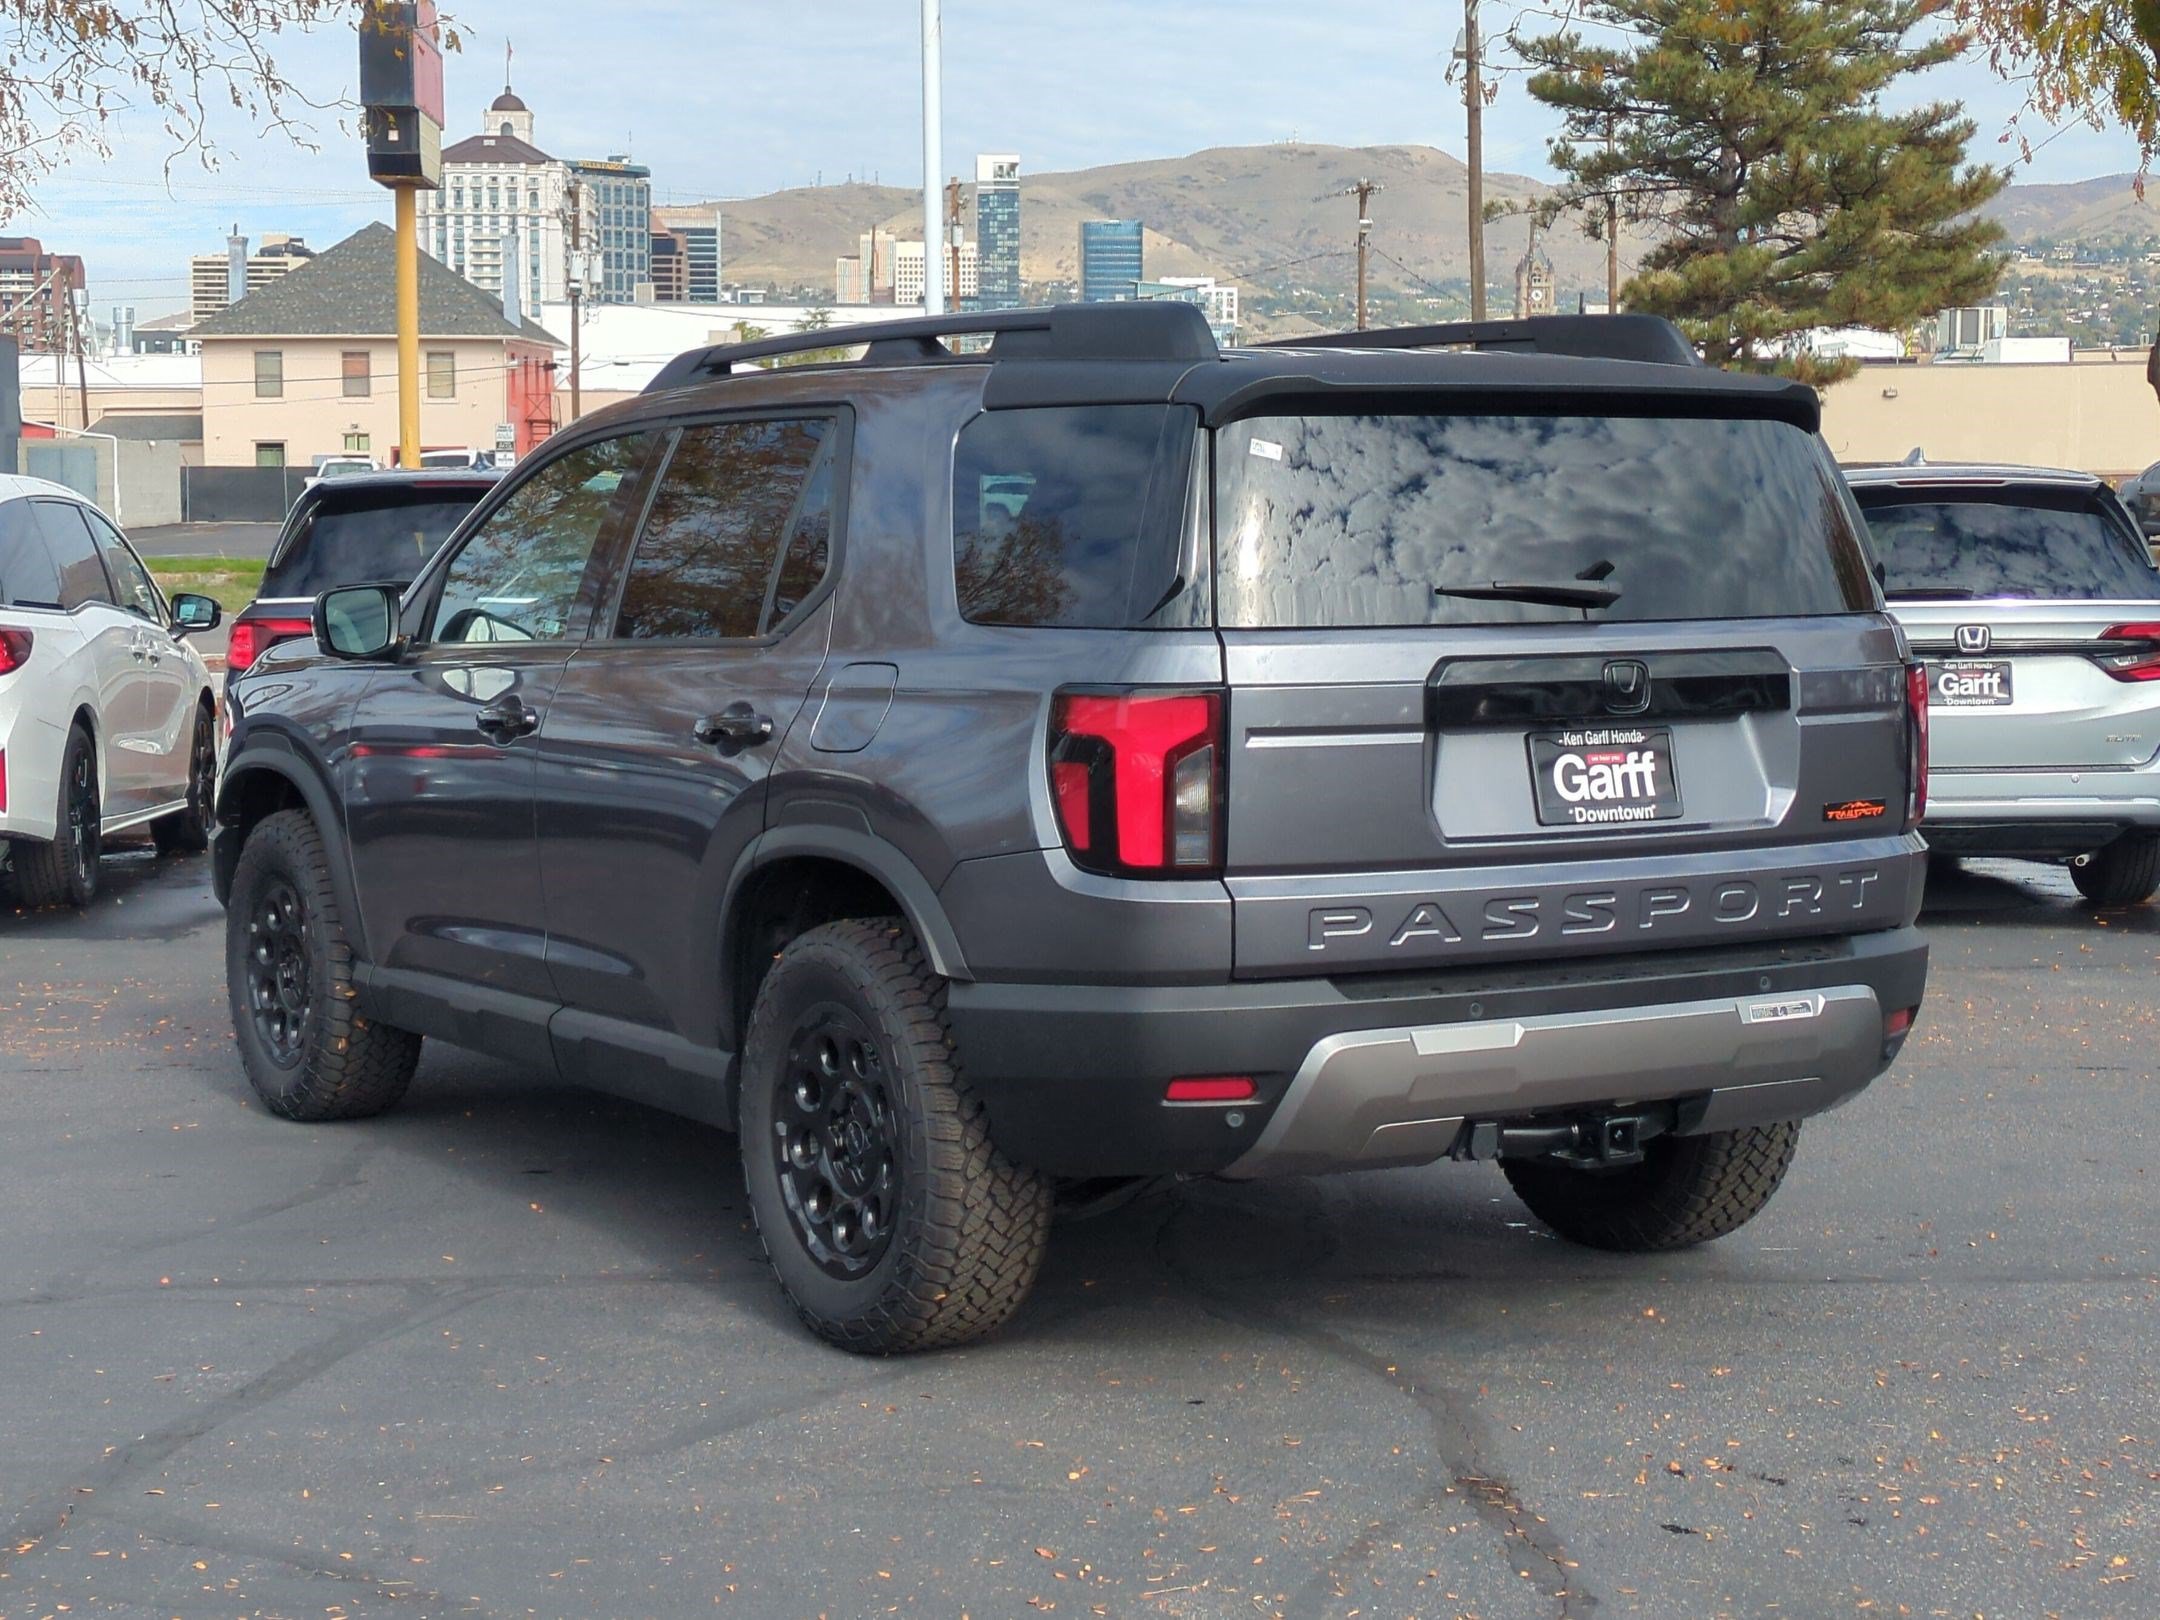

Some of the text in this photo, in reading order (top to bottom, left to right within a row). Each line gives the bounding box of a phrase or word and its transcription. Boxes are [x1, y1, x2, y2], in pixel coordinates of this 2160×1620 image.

[1938, 672, 2000, 695] Garff
[1946, 697, 1994, 705] Downtown
[1563, 729, 1642, 747] Ken Garff Honda
[1553, 750, 1656, 802] Garff
[1574, 804, 1654, 823] Downtown
[1827, 806, 1885, 820] TRAILSPORT
[1307, 868, 1878, 951] PASSPORT
